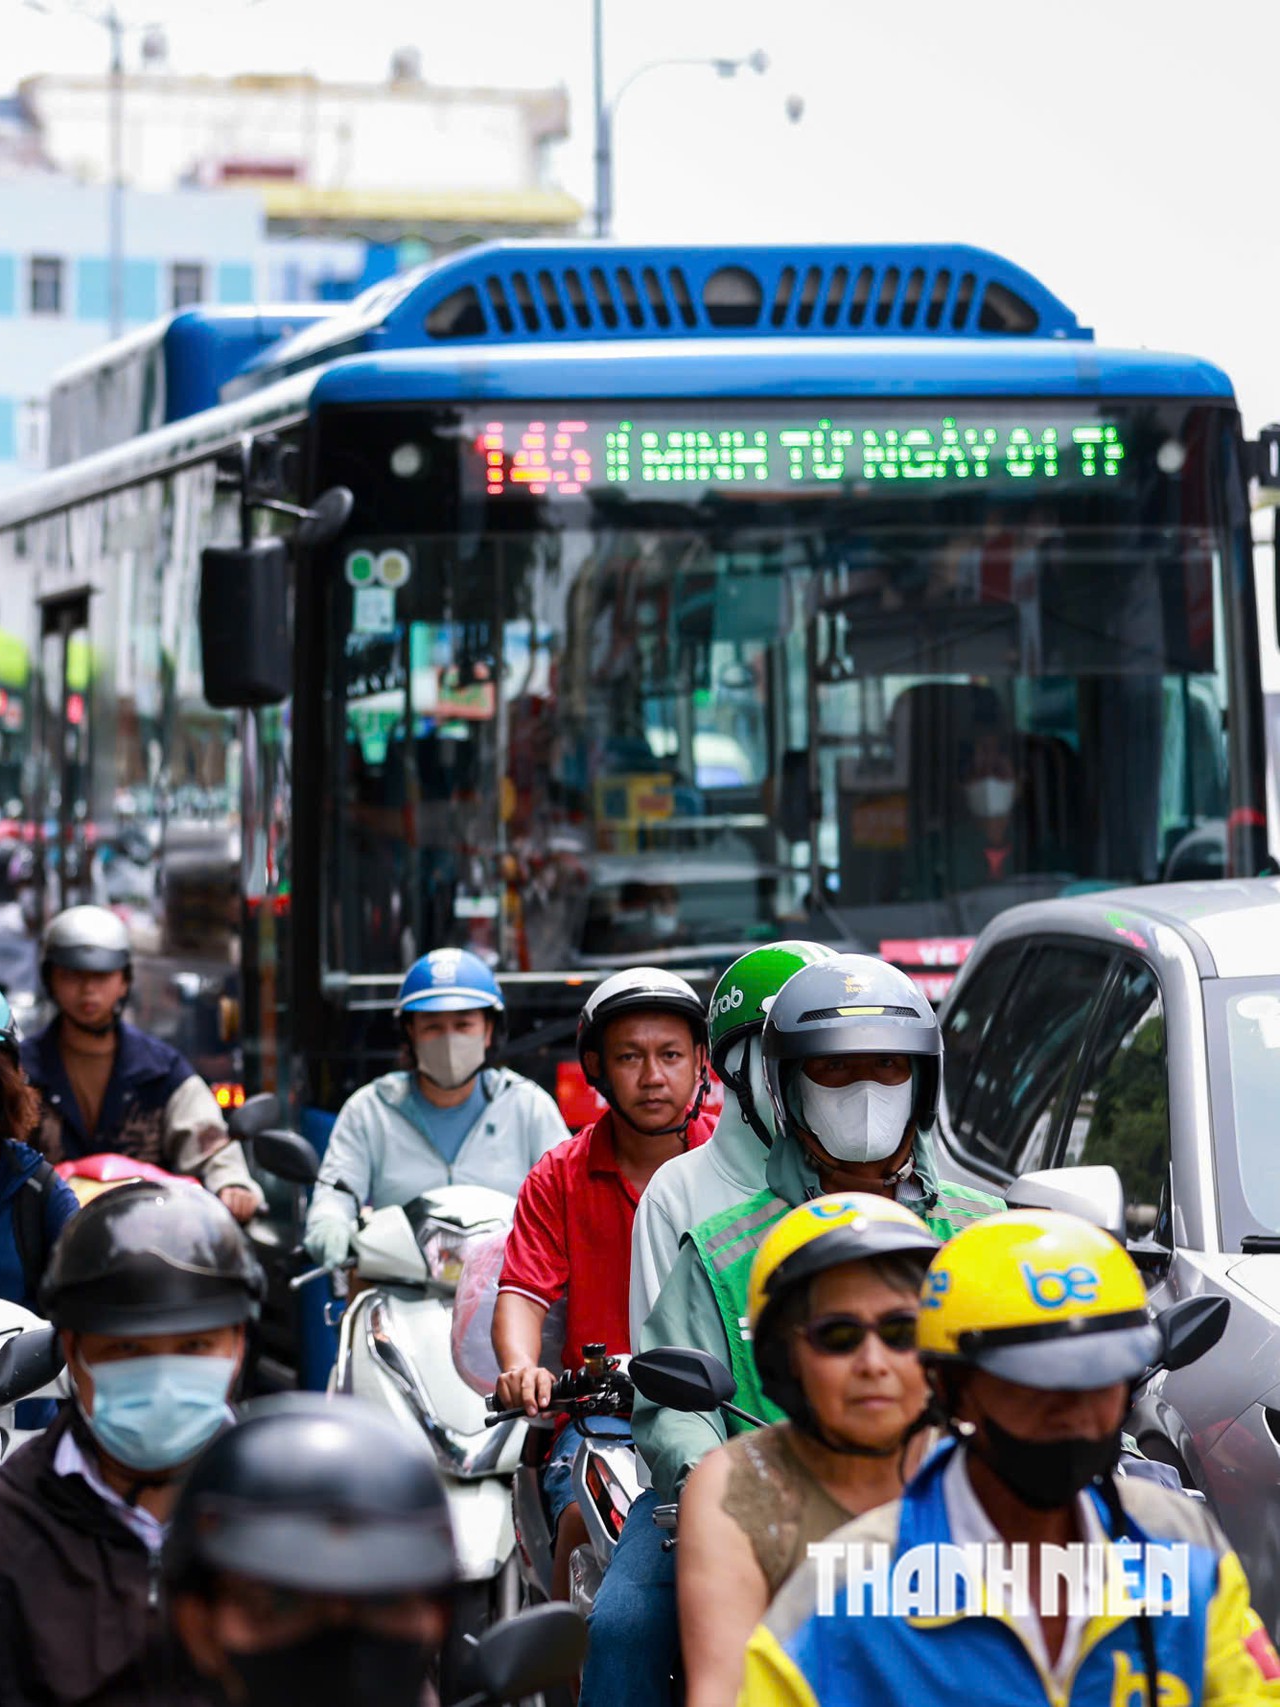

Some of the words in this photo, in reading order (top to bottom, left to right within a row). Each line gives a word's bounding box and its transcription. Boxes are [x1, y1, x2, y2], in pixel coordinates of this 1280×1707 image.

[483, 421, 593, 494] 145
[641, 431, 768, 480] MINH
[1023, 1263, 1098, 1309] be
